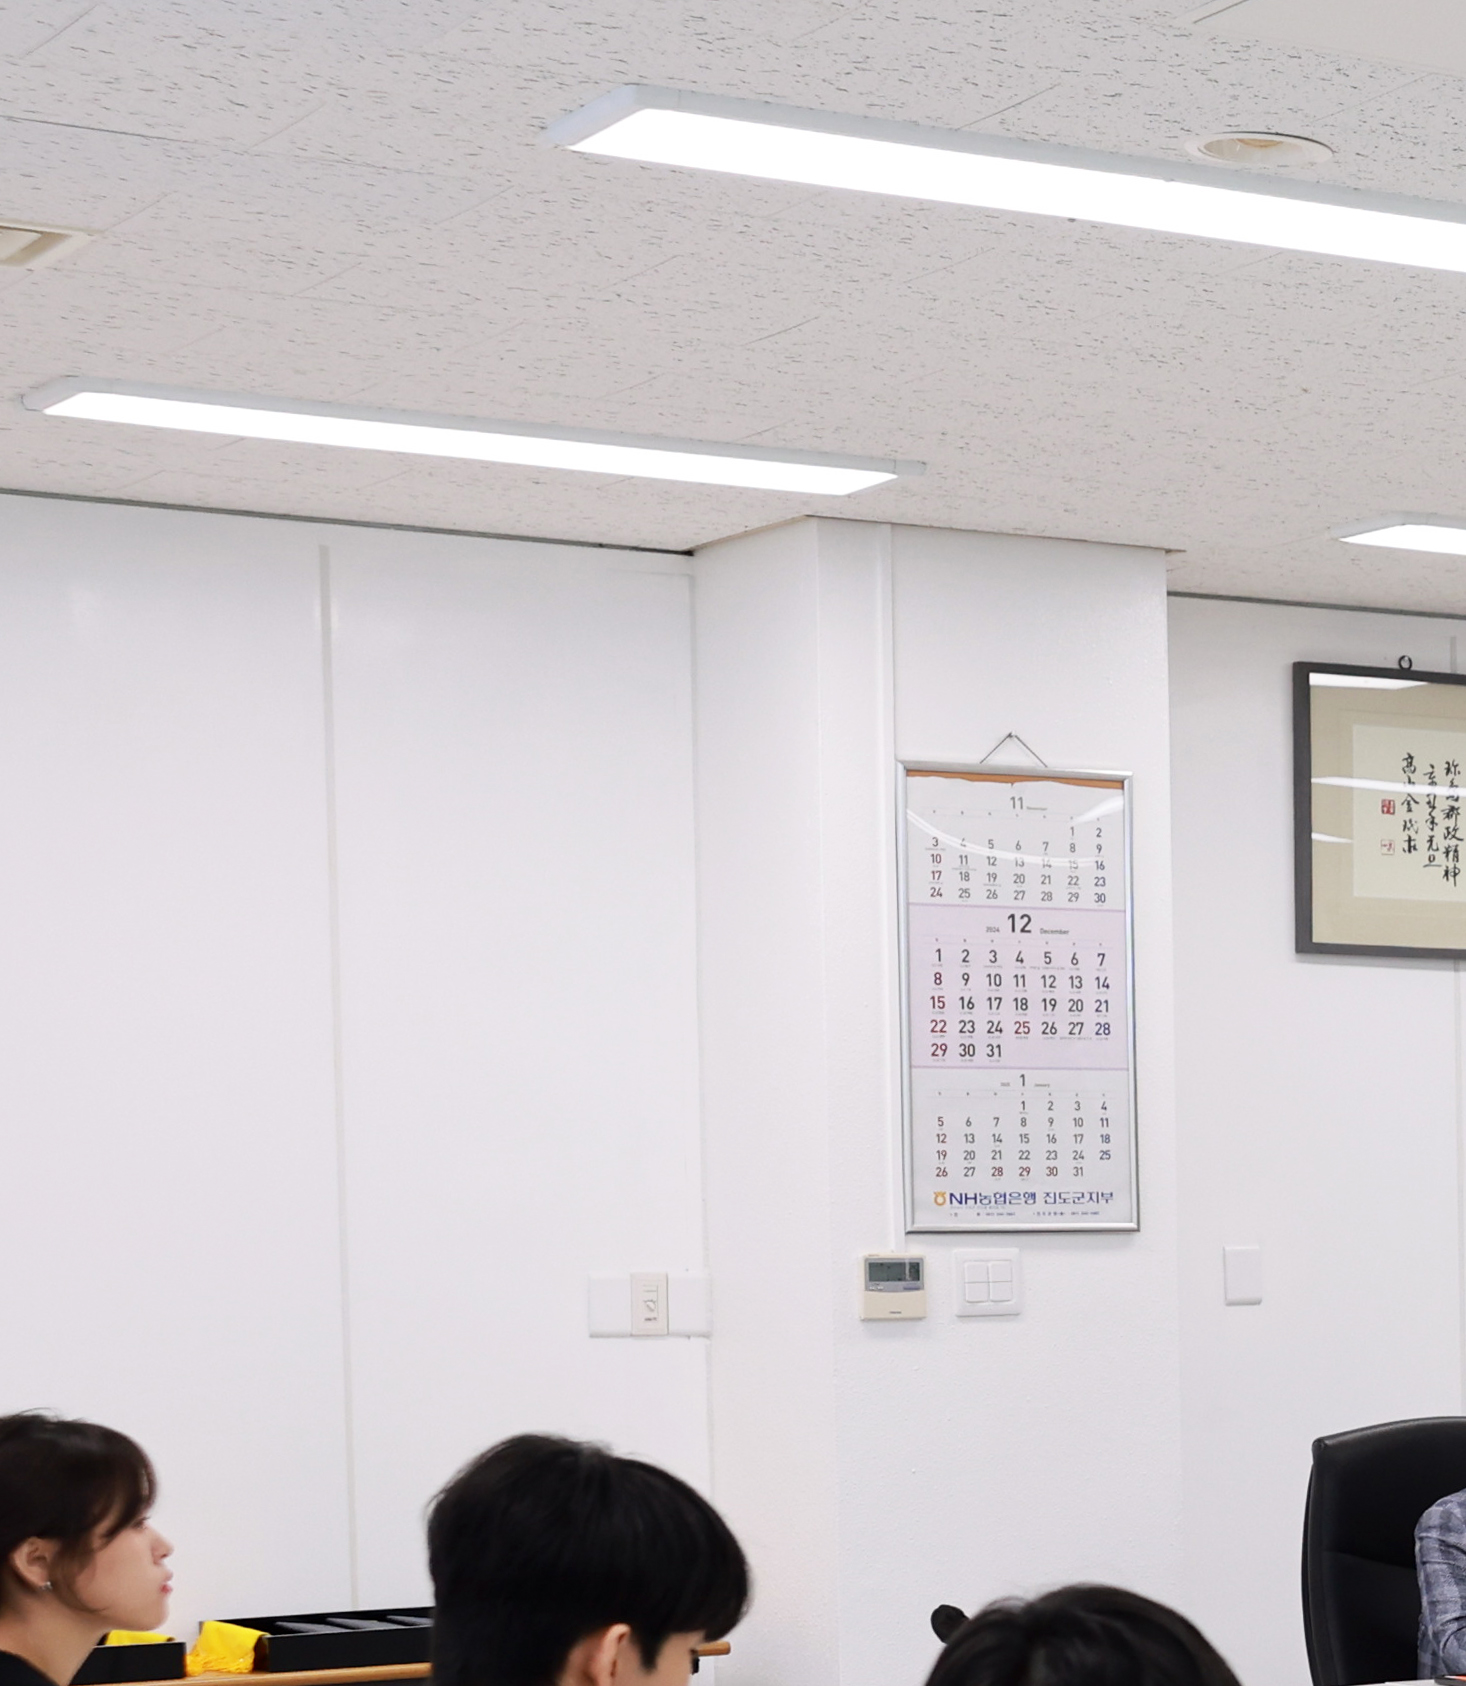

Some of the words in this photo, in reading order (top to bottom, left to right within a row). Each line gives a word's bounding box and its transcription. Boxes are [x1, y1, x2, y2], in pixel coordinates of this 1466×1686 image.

[1007, 913, 1032, 934] 12
[1040, 927, 1070, 936] December
[936, 949, 941, 962] 1
[962, 949, 969, 963] 2
[990, 950, 997, 963] 3
[1016, 951, 1023, 963] 4
[1044, 952, 1051, 964] 5
[1071, 953, 1078, 965] 6
[1098, 953, 1105, 966] 7
[934, 972, 942, 985] 8
[962, 973, 969, 986] 9
[987, 974, 1001, 987] 10
[1014, 974, 1025, 987] 11
[1041, 975, 1056, 988] 12
[1069, 976, 1082, 989] 13
[1096, 977, 1109, 989] 14
[930, 996, 945, 1009] 15
[960, 997, 974, 1010] 16
[987, 997, 1002, 1010] 17
[1013, 998, 1028, 1011] 18
[1042, 998, 1056, 1011] 19
[1069, 999, 1083, 1012] 20
[1095, 999, 1108, 1012] 21
[931, 1020, 946, 1033] 22
[959, 1020, 975, 1033] 23
[987, 1021, 1002, 1033] 24
[1015, 1021, 1030, 1034] 25
[1042, 1022, 1057, 1035] 26
[1069, 1022, 1083, 1035] 27
[1095, 1023, 1110, 1035] 28
[932, 1043, 947, 1056] 29
[960, 1043, 975, 1057] 30
[987, 1044, 1001, 1057] 31
[1018, 1073, 1027, 1087] 1
[1022, 1101, 1025, 1110] 1
[1048, 1101, 1053, 1110] 2
[1075, 1101, 1080, 1111] 3
[1102, 1102, 1107, 1110] 4
[938, 1117, 943, 1126] 5
[966, 1117, 971, 1127] 6
[994, 1117, 999, 1126] 7
[1021, 1117, 1026, 1127] 8
[1048, 1118, 1054, 1126] 9
[1073, 1117, 1083, 1127] 10
[1100, 1118, 1108, 1127] 11
[949, 1192, 1037, 1206] NH농협은행
[1042, 1191, 1114, 1206] 진도군지부
